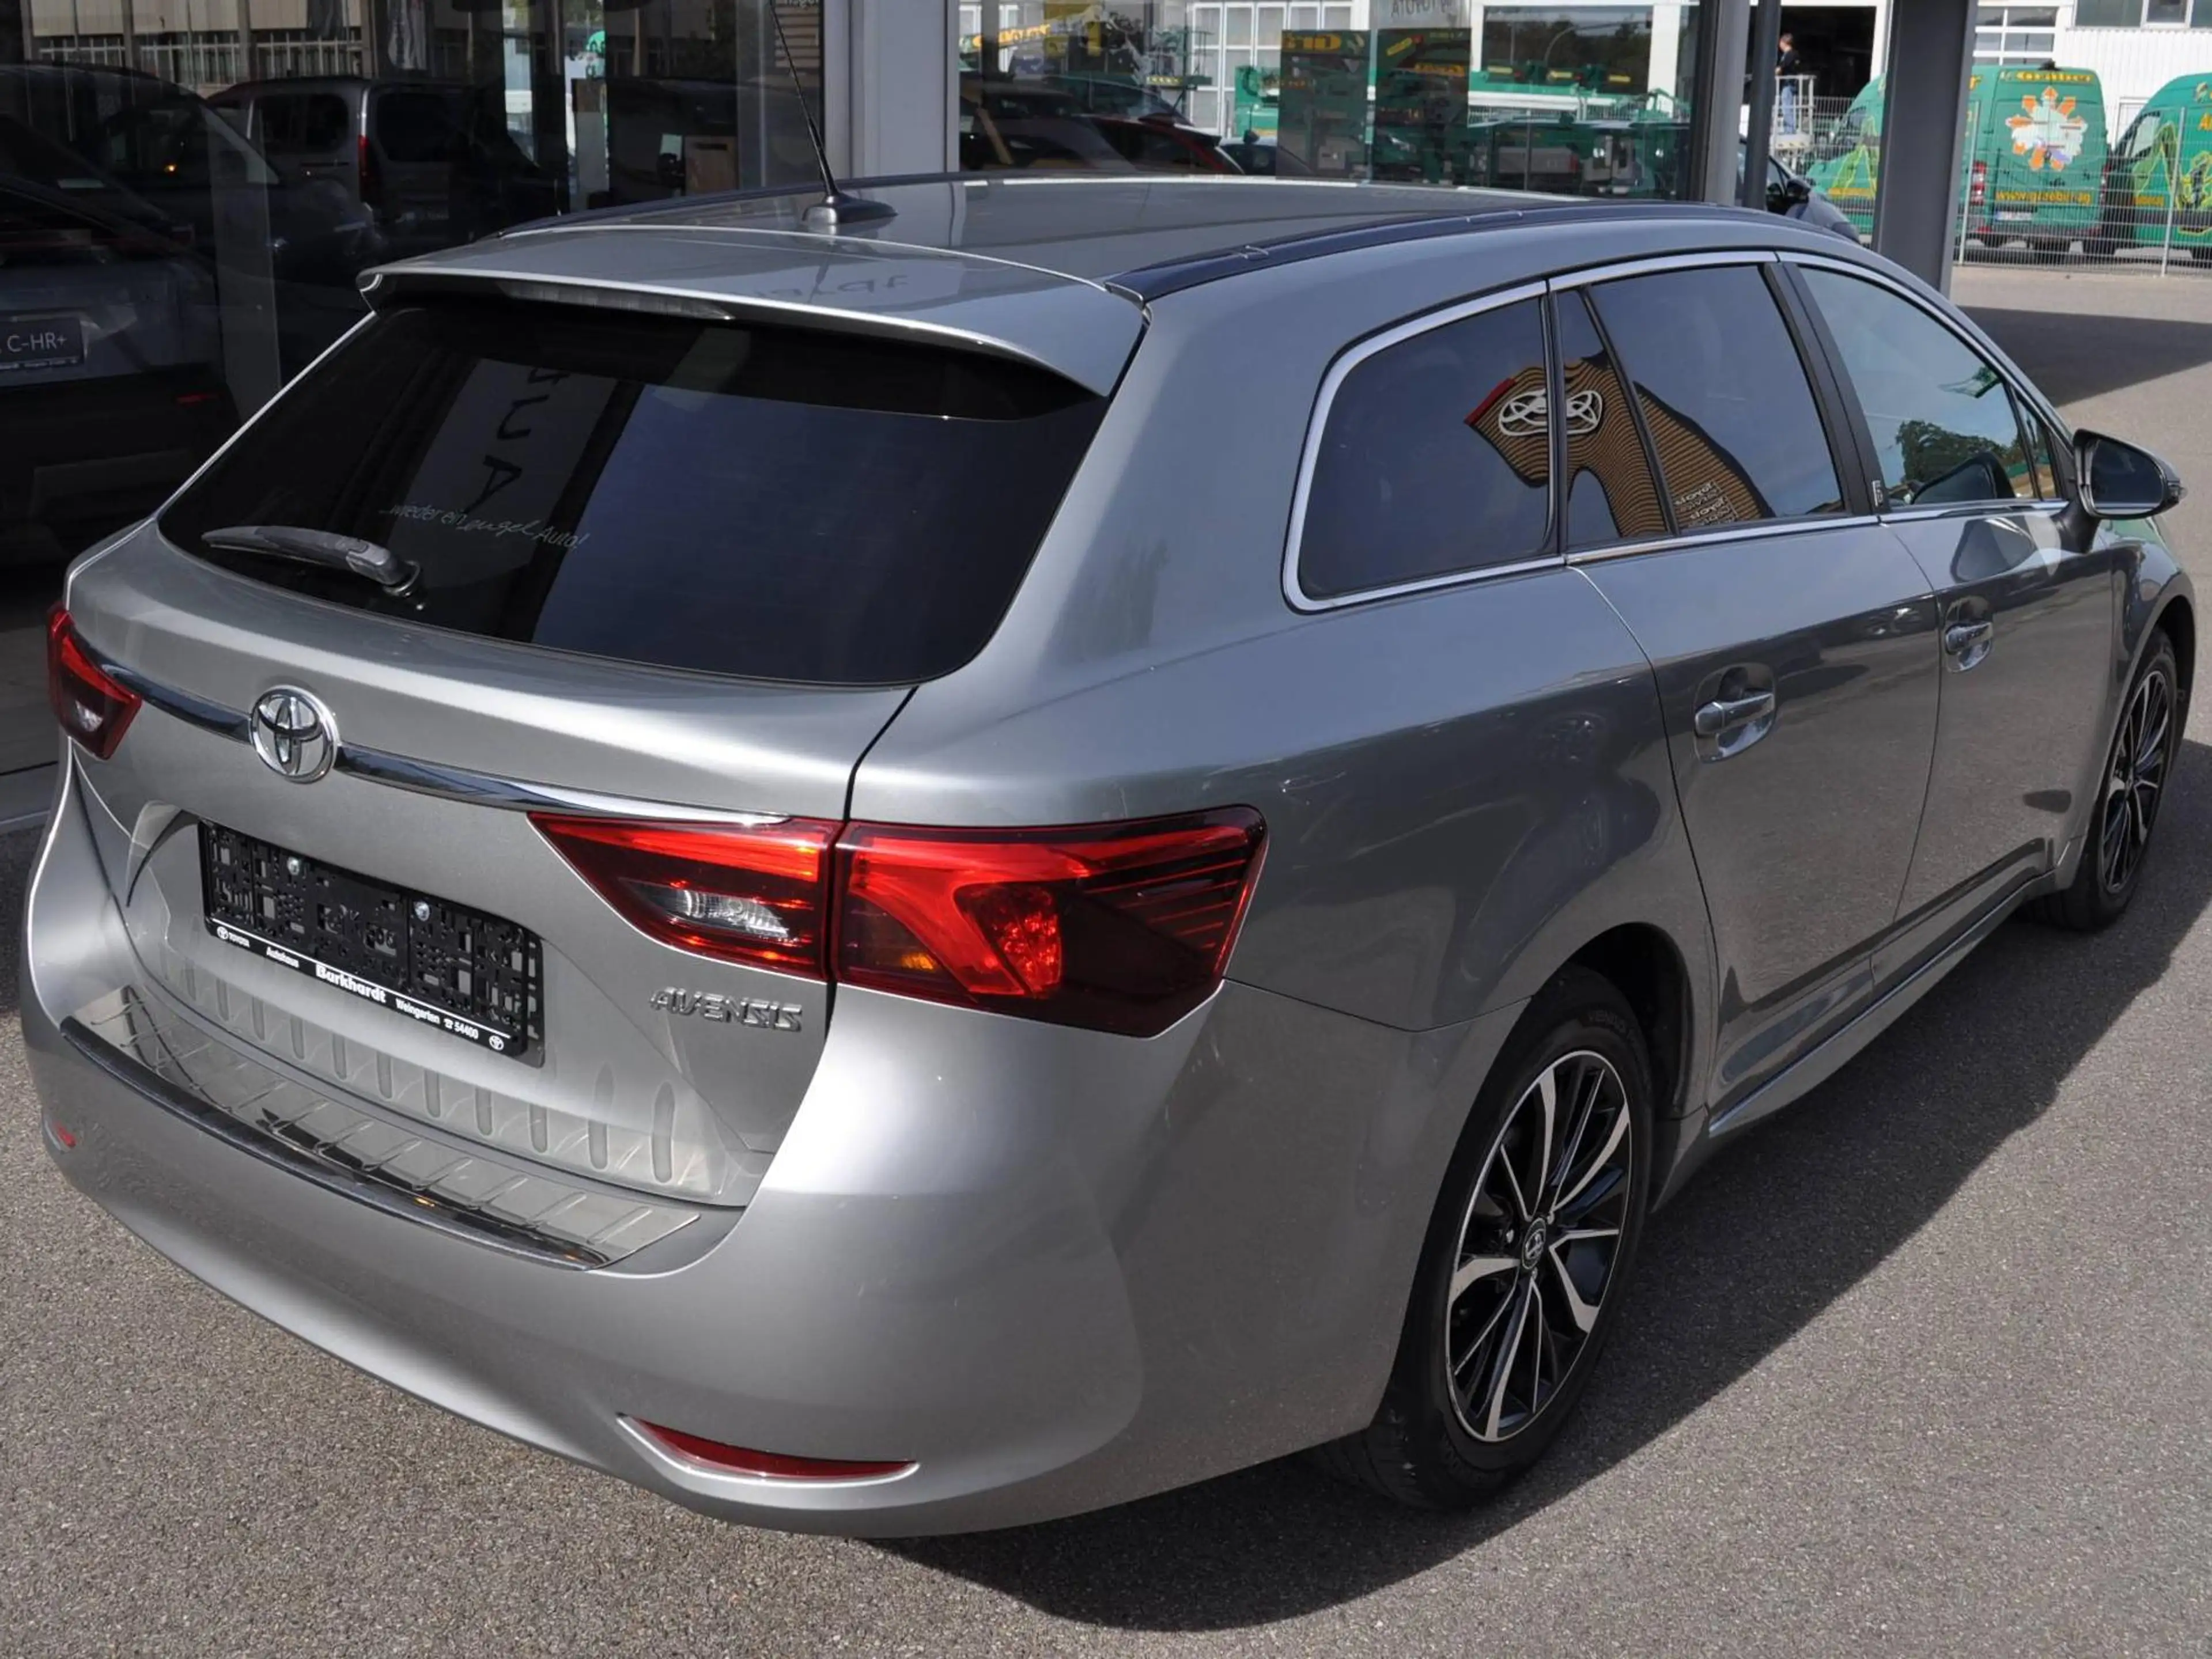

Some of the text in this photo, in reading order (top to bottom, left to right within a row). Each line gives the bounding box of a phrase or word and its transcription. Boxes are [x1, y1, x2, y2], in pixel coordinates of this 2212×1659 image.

[6, 331, 68, 353] C-HR+
[266, 946, 300, 968] Autohaus
[315, 964, 387, 1003] Burkhardt
[395, 998, 441, 1025] Weingarten
[649, 986, 803, 1032] AVENSIS
